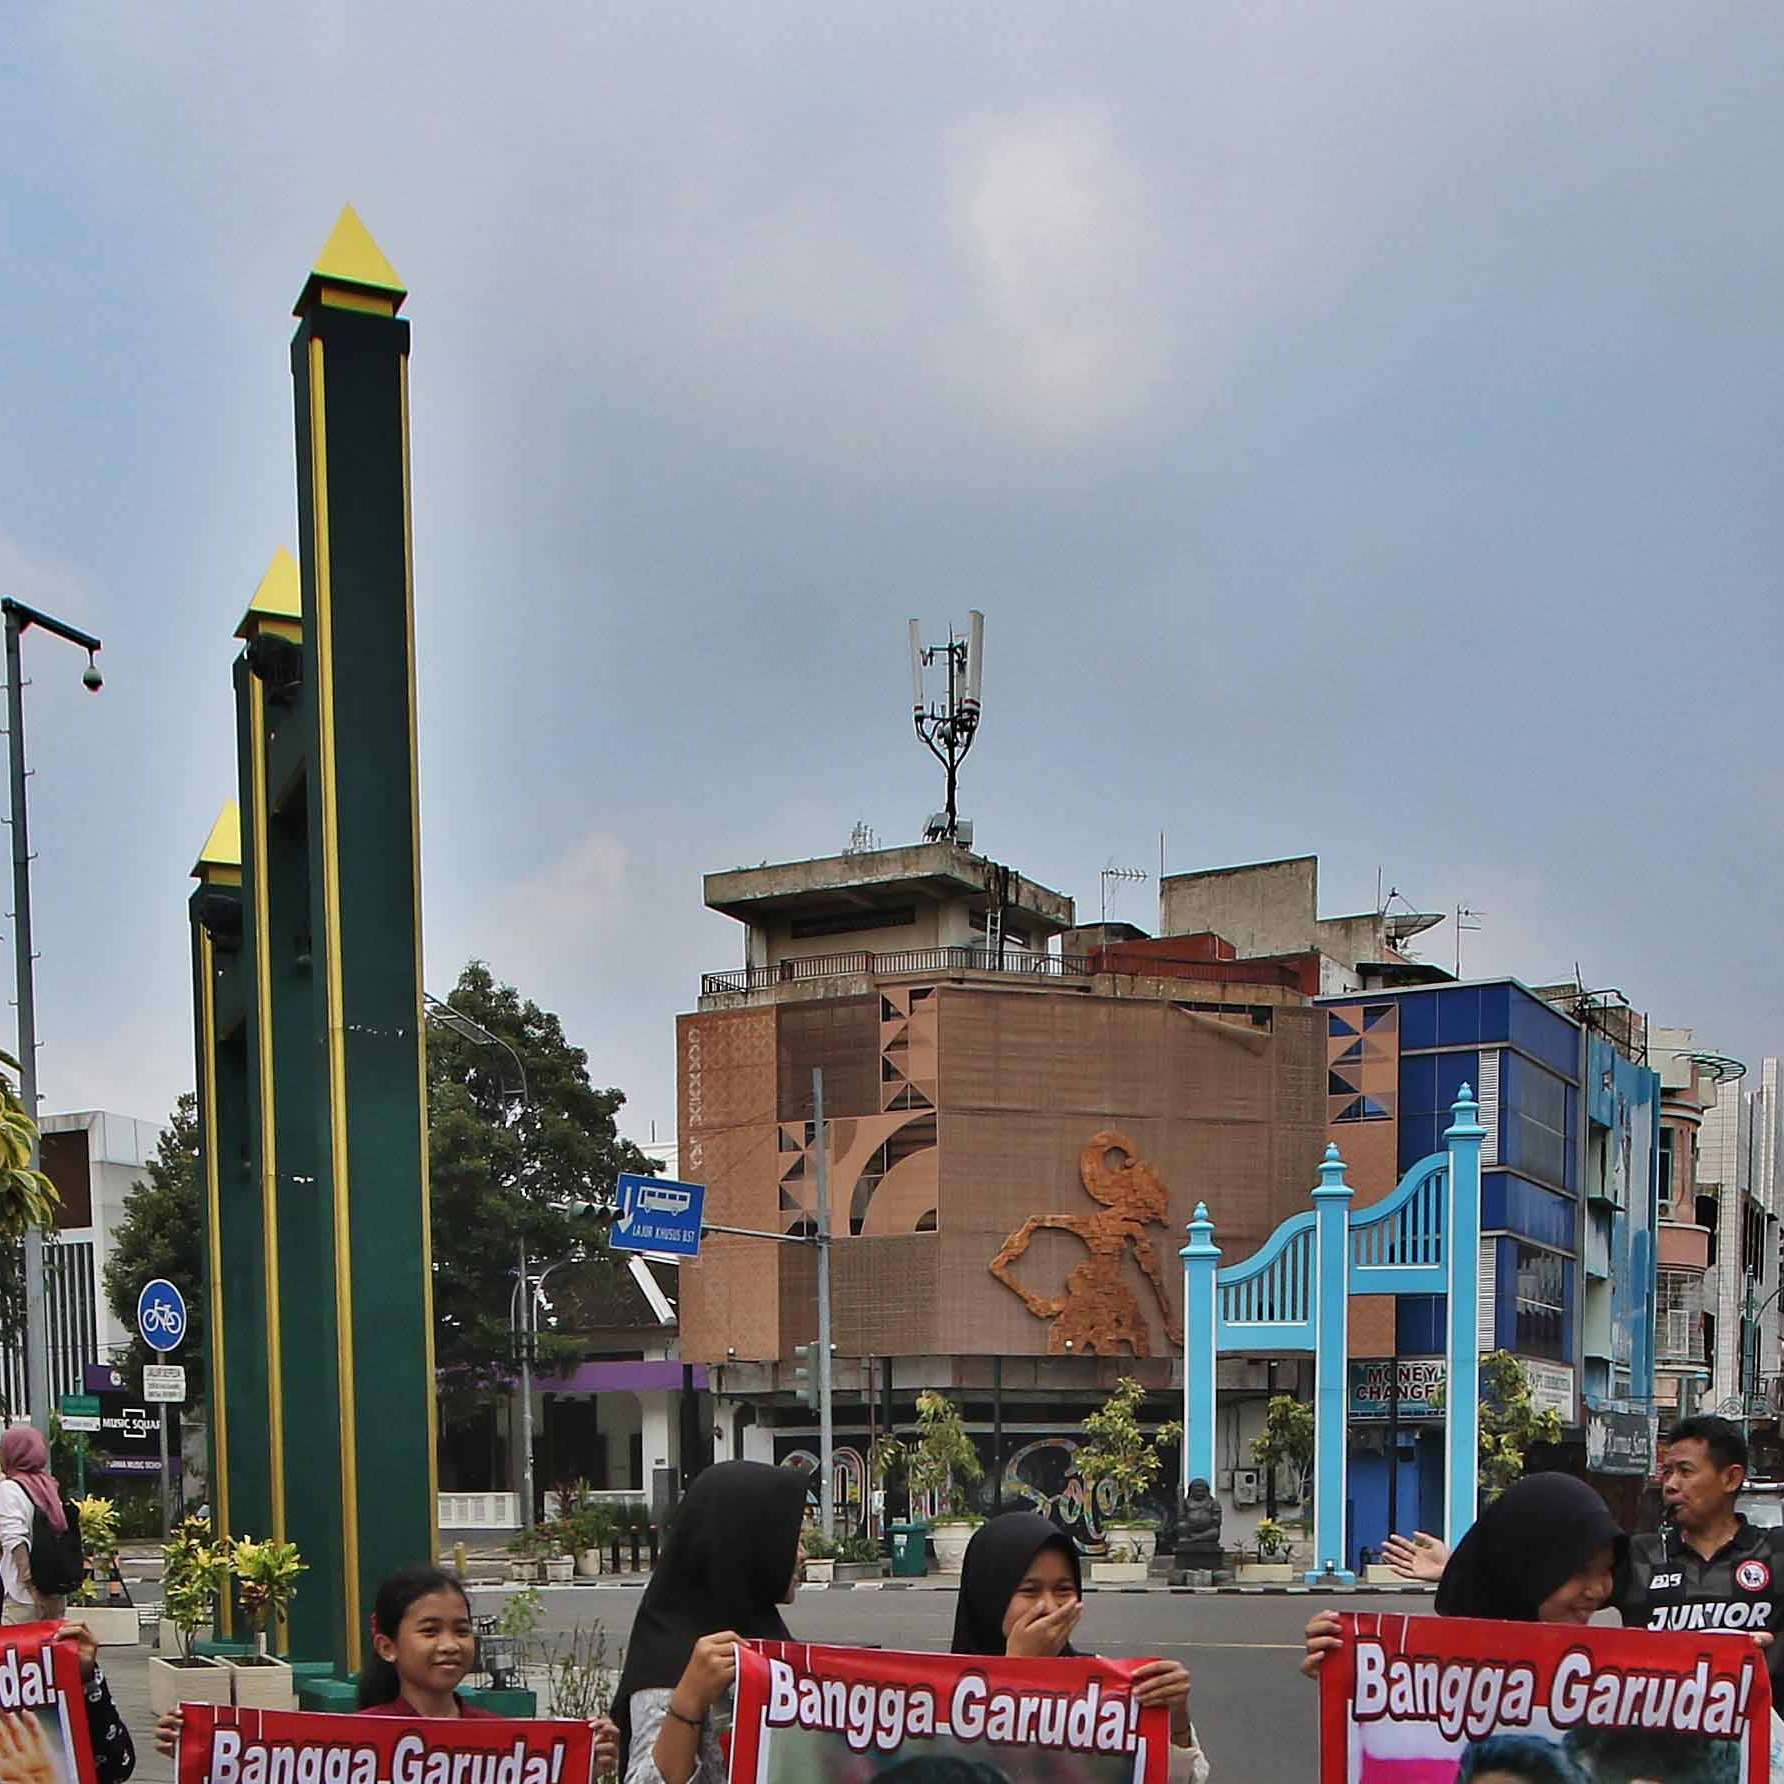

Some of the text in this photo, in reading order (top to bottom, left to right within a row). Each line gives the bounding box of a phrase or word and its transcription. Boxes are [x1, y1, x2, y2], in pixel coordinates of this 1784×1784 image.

[1368, 1366, 1438, 1383] MONEY
[102, 1417, 131, 1428] MUSIC
[1647, 1601, 1772, 1631] JUNIOR
[1353, 1640, 1754, 1738] Bangga Garuda!
[768, 1657, 1140, 1752] Bangga Garuda!
